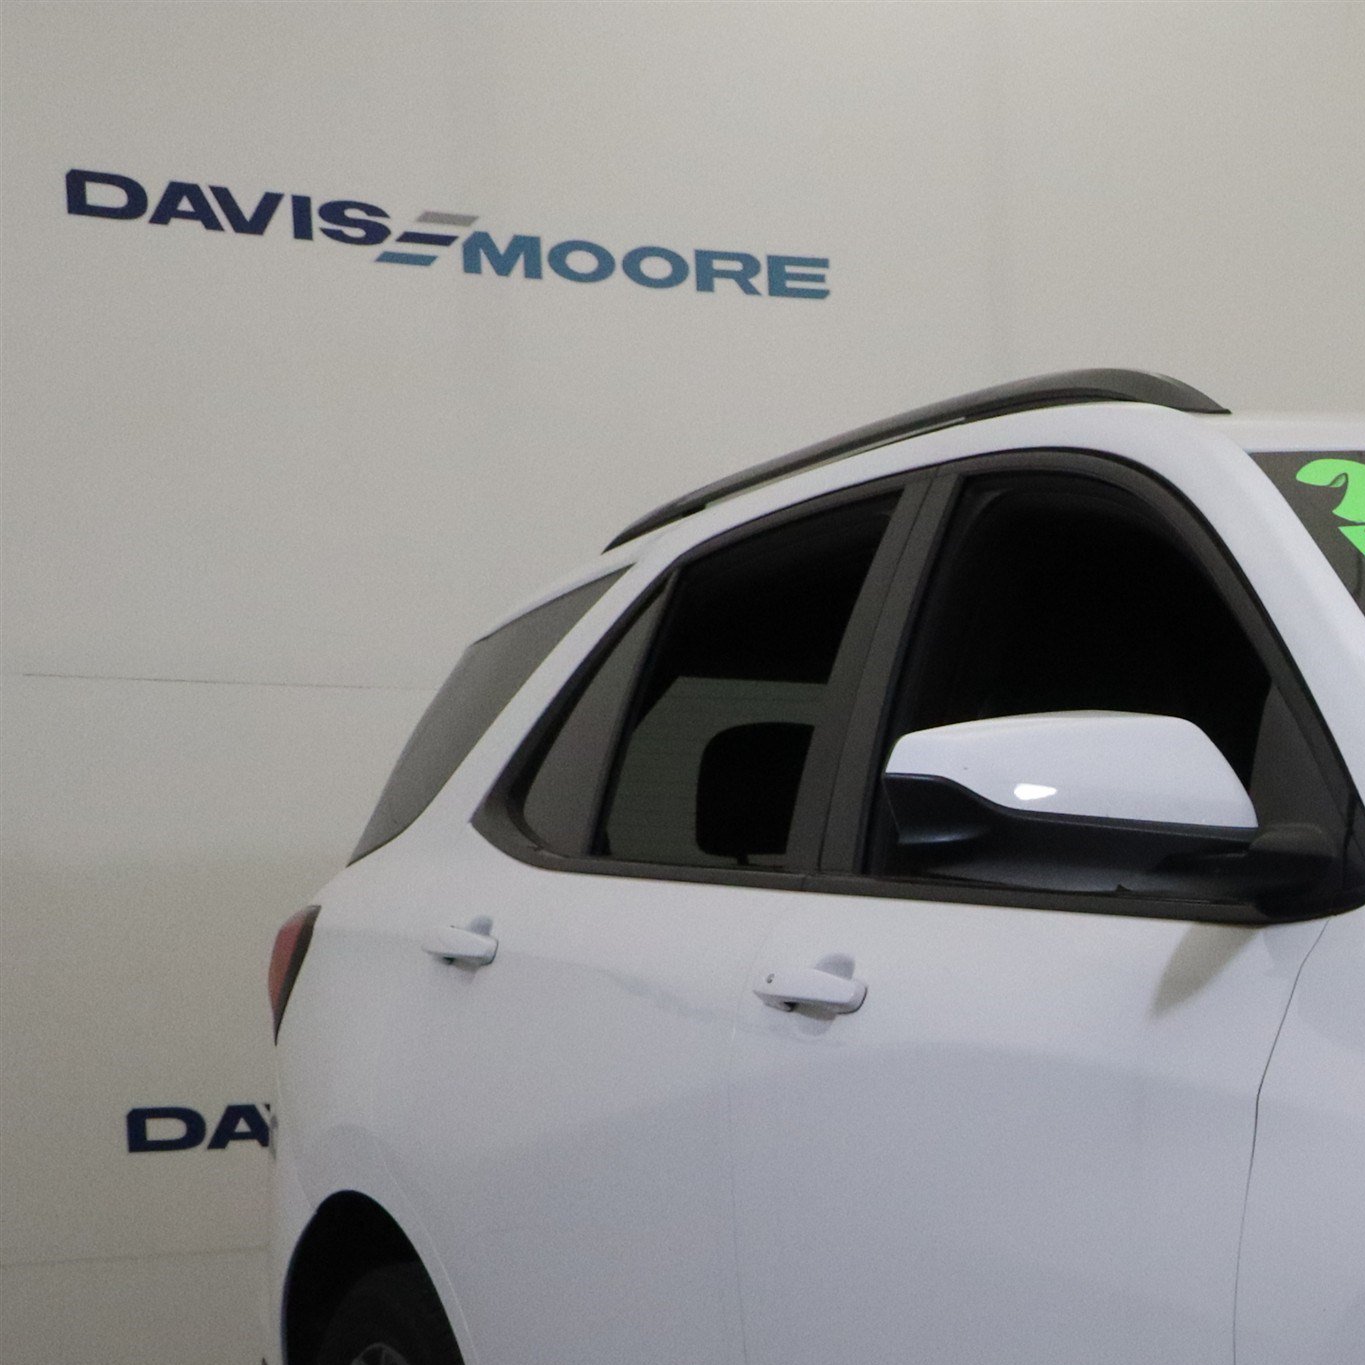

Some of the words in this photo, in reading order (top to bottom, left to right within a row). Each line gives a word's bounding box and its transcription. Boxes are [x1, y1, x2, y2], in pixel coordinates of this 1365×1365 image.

[65, 168, 392, 247] DAVIS
[461, 231, 831, 300] MOORE
[126, 1103, 271, 1154] DA
